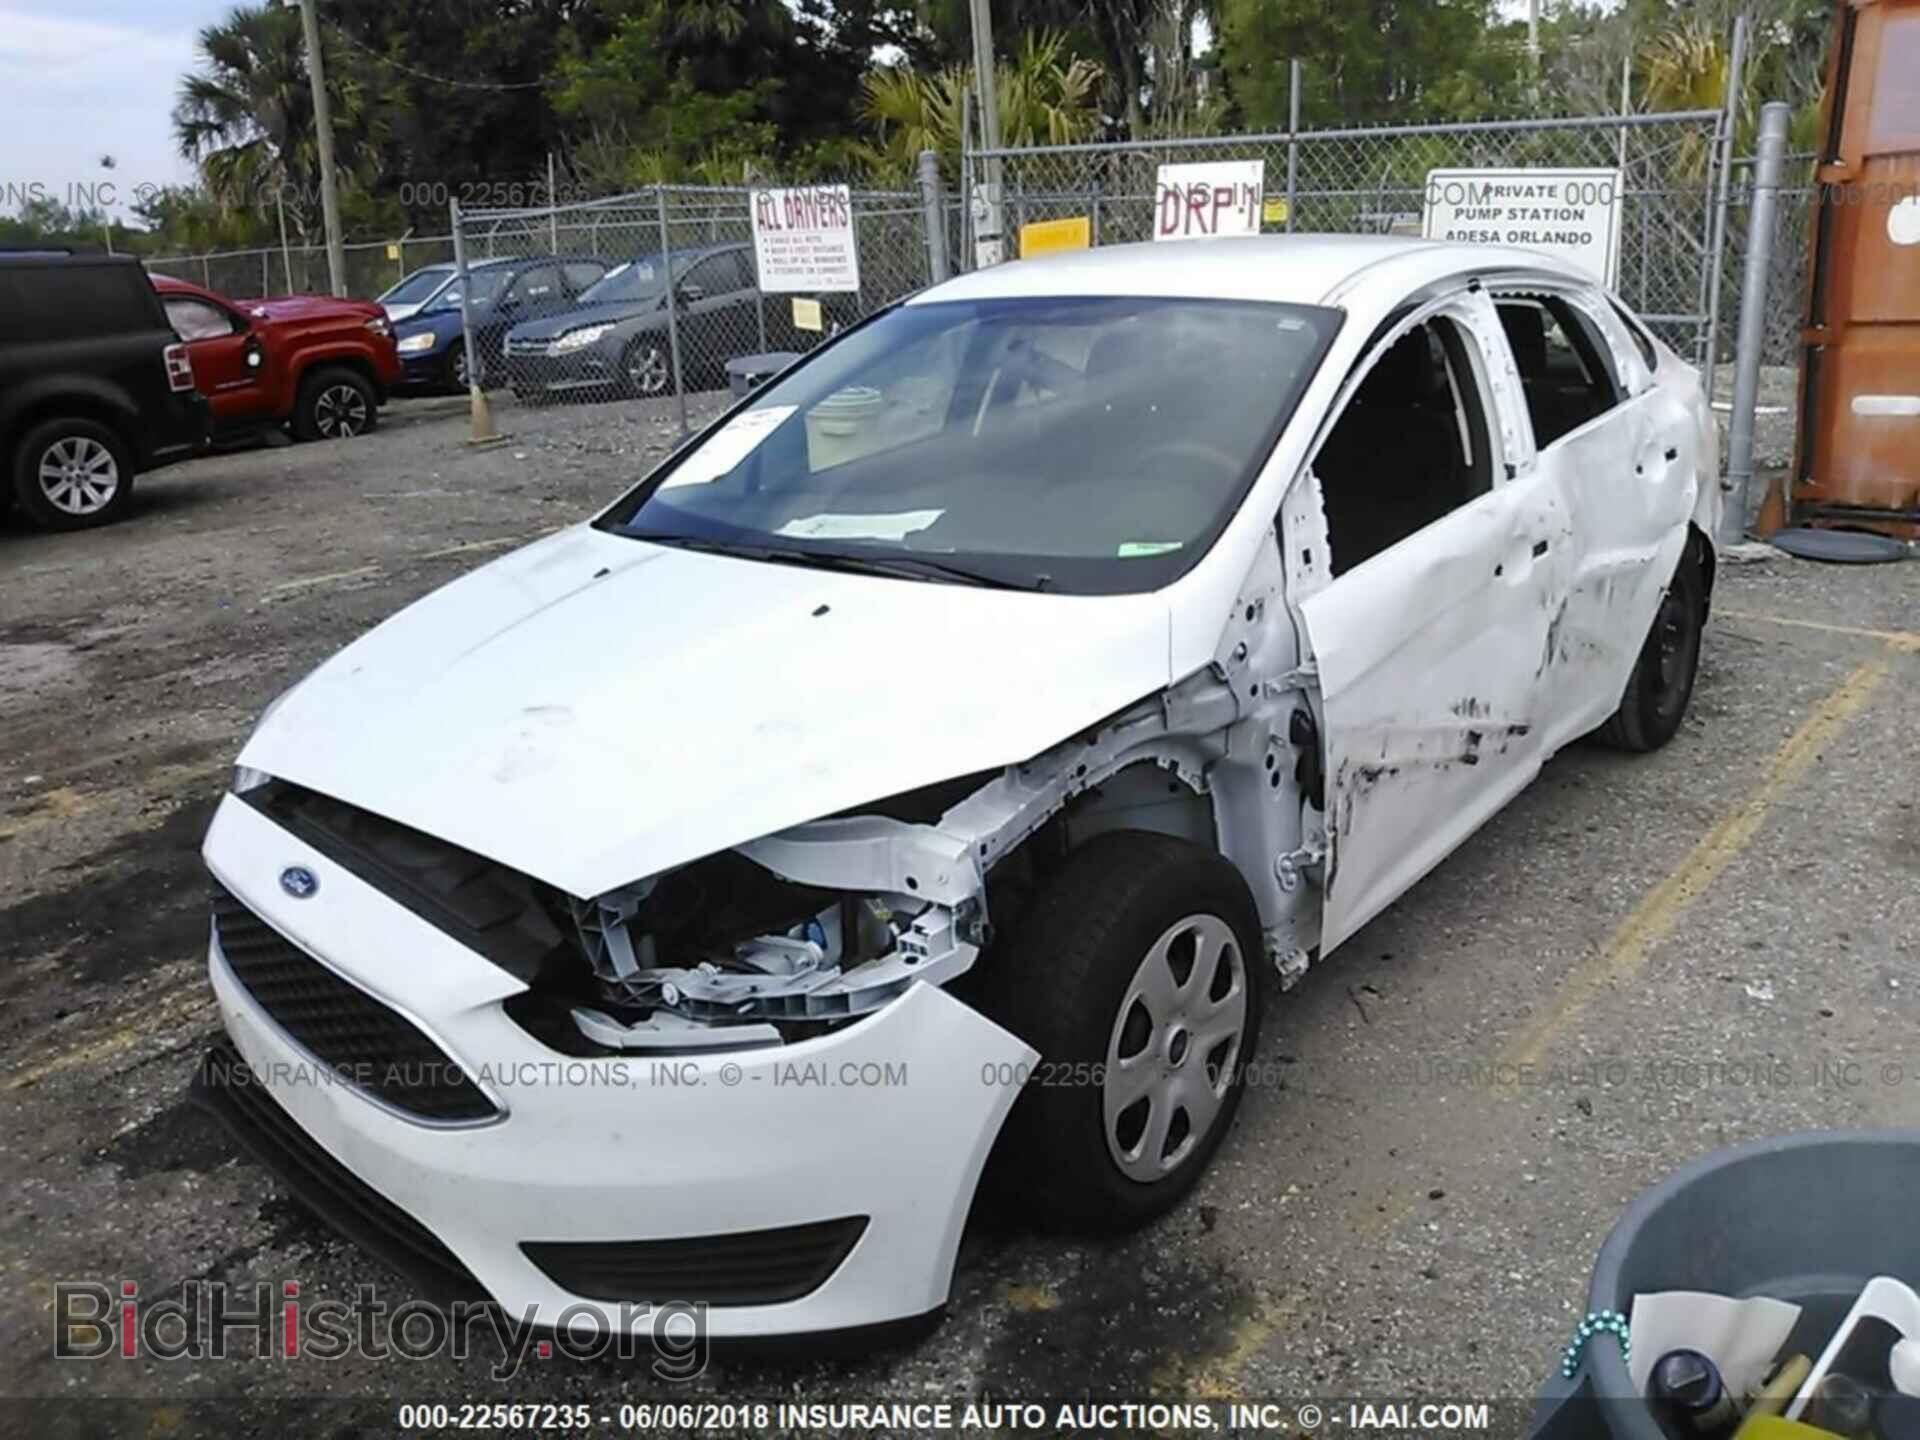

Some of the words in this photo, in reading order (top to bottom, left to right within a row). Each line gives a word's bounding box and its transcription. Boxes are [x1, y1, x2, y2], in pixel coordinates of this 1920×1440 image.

[1486, 185, 1557, 198] PRIVATE
[757, 193, 782, 231] ALL
[784, 191, 848, 230] DRIVERS
[1454, 207, 1502, 221] PUMP
[1507, 207, 1586, 221] STATION
[1446, 230, 1501, 243] ADESA
[1506, 230, 1593, 245] ORLANDO
